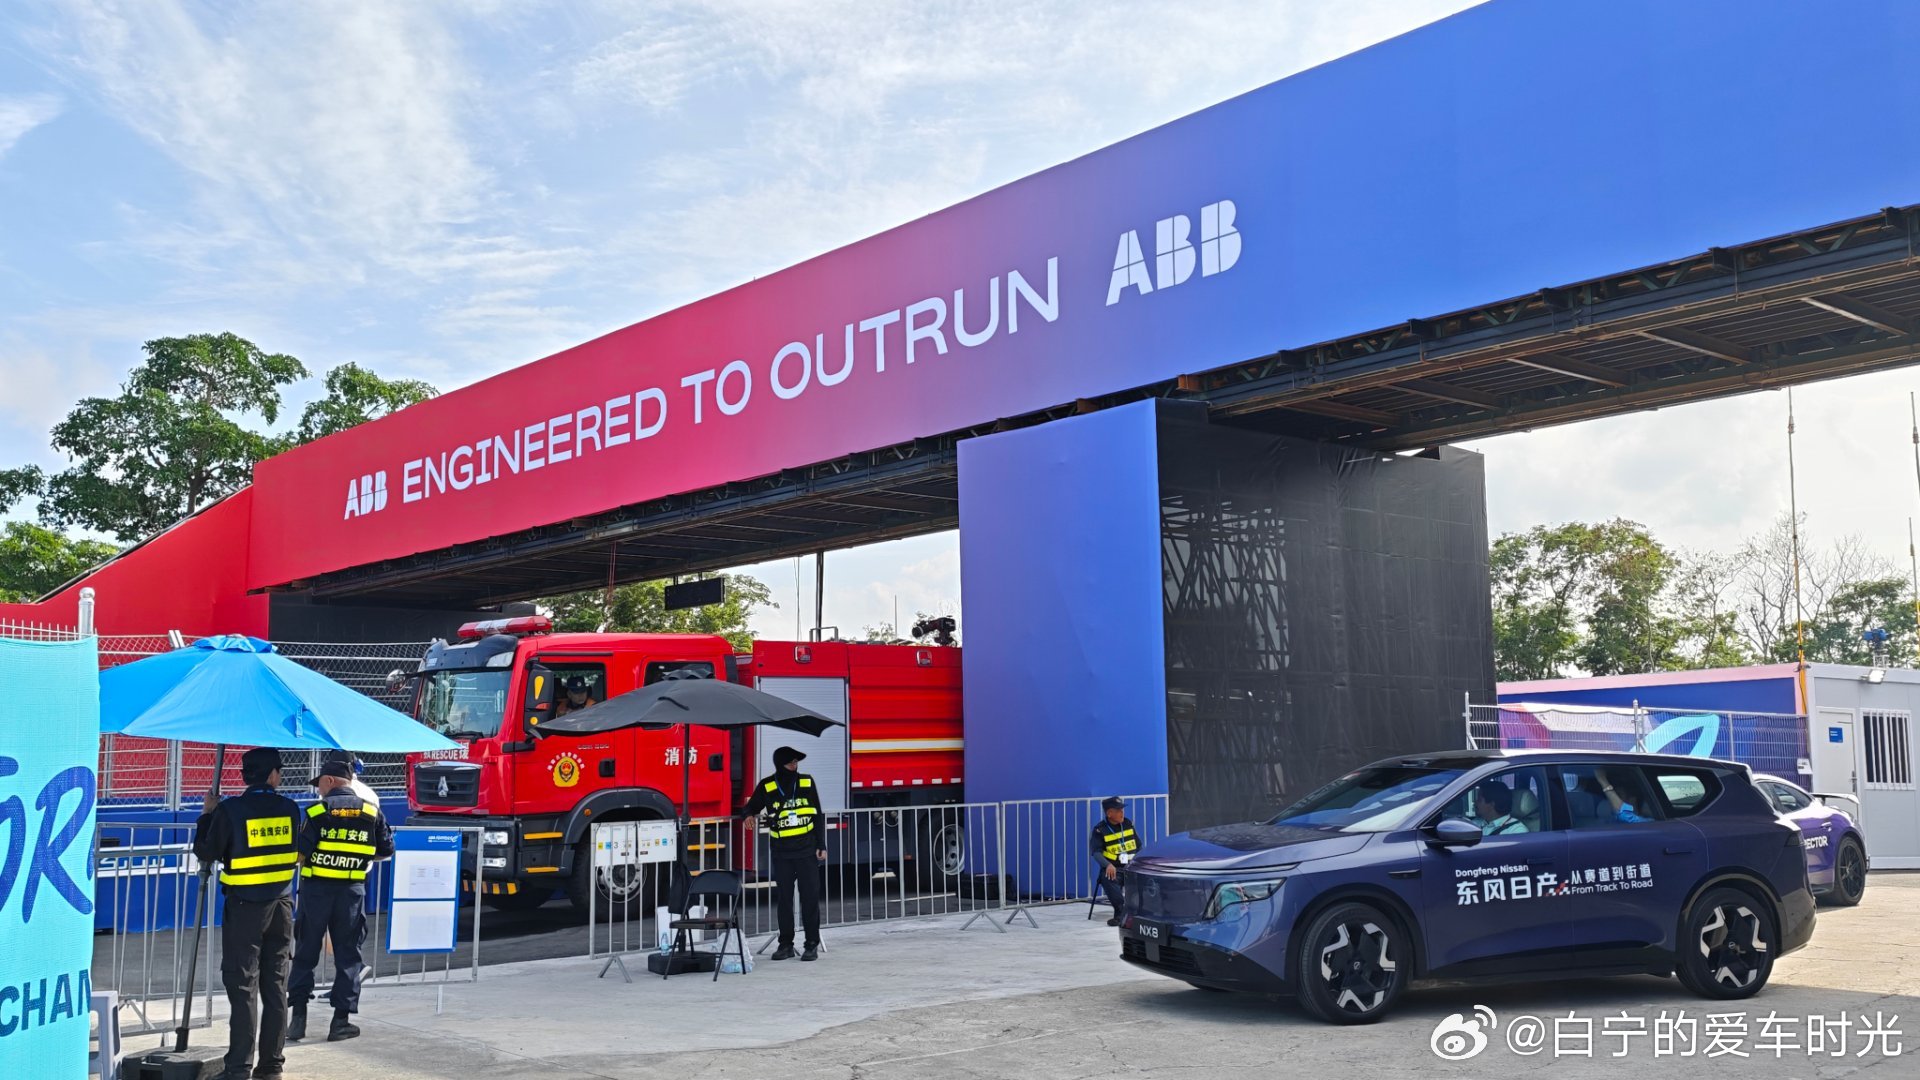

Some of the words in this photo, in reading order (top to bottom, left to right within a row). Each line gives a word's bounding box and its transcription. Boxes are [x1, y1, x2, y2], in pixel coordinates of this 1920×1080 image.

[344, 471, 388, 520] ABB
[404, 388, 667, 503] ENGINEERED
[681, 360, 752, 424] TO
[770, 257, 1059, 400] OUTRUN
[1105, 199, 1243, 306] ABB
[431, 749, 458, 760] RESCUE
[310, 852, 363, 869] SECURITY
[1456, 867, 1498, 878] Dongfeng
[1500, 864, 1529, 873] Nissan
[1571, 863, 1652, 885] 从赛道到街道
[1456, 872, 1559, 906] 东风日产
[1571, 885, 1595, 895] From
[1595, 883, 1619, 892] Track
[1620, 882, 1630, 890] To
[1632, 879, 1654, 888] Road
[1139, 924, 1159, 938] NX8
